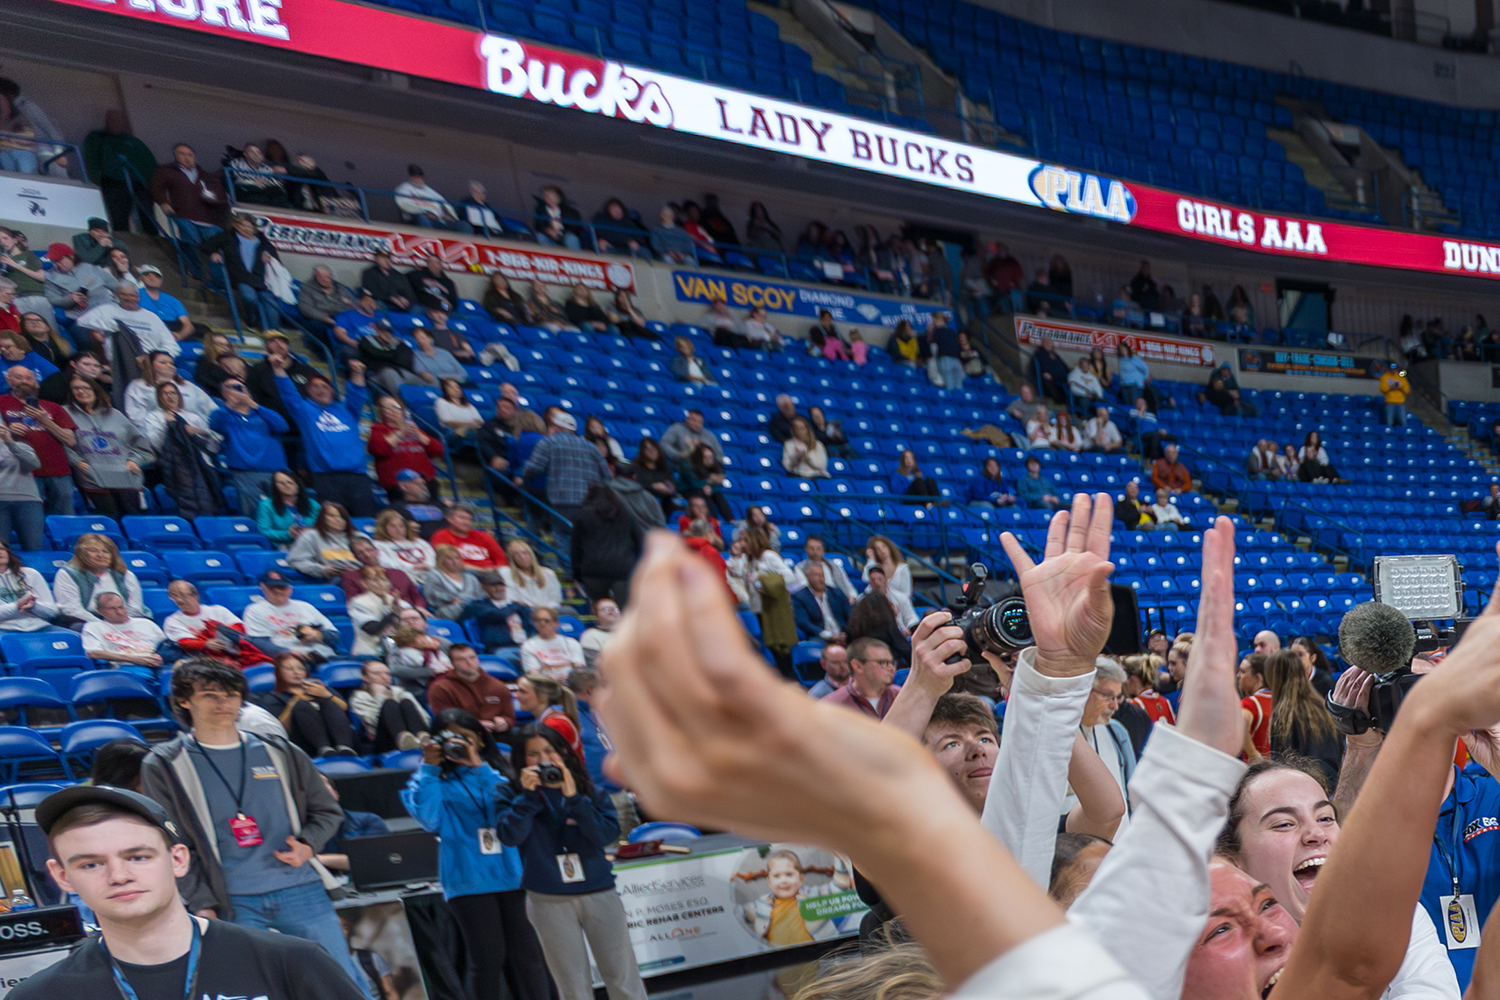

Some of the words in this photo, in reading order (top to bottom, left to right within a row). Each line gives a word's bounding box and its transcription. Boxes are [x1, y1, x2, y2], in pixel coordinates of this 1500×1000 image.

[478, 33, 675, 130] Bucks
[715, 97, 833, 153] LADY
[849, 128, 976, 183] BUCKS
[1043, 166, 1132, 224] PIAA
[1176, 198, 1256, 245] GIRLS
[1261, 218, 1328, 255] AAA
[675, 274, 727, 301] VAN
[731, 281, 796, 312] SCOY
[1462, 818, 1482, 840] FOX
[681, 905, 725, 920] CENTERS
[805, 899, 828, 911] HELP
[815, 903, 851, 916] DREAMS
[1449, 903, 1467, 942] PIAA
